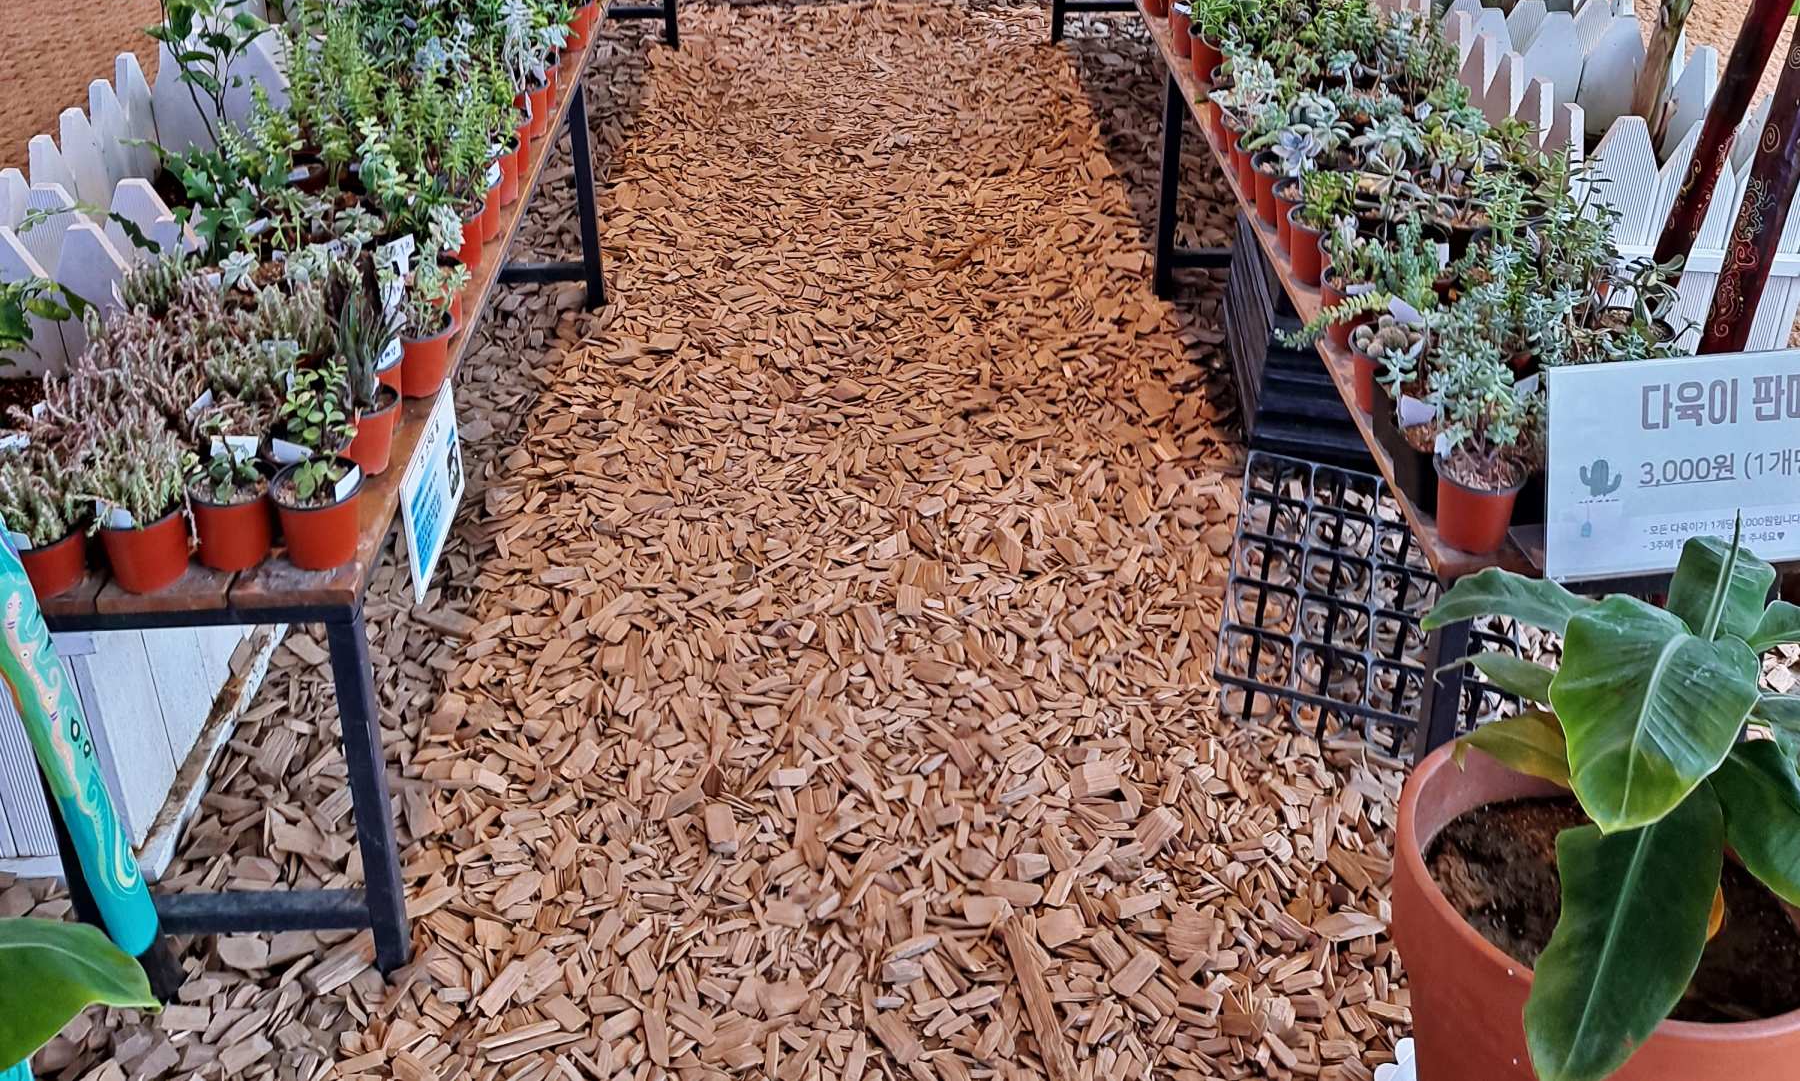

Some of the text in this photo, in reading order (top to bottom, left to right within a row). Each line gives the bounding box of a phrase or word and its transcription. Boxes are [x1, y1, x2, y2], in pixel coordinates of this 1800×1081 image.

[1641, 378, 1738, 430] 다육이
[1639, 452, 1735, 487] 3,000원
[1649, 513, 1800, 536] 모든 다육이가 1개당 ,000원입니다
